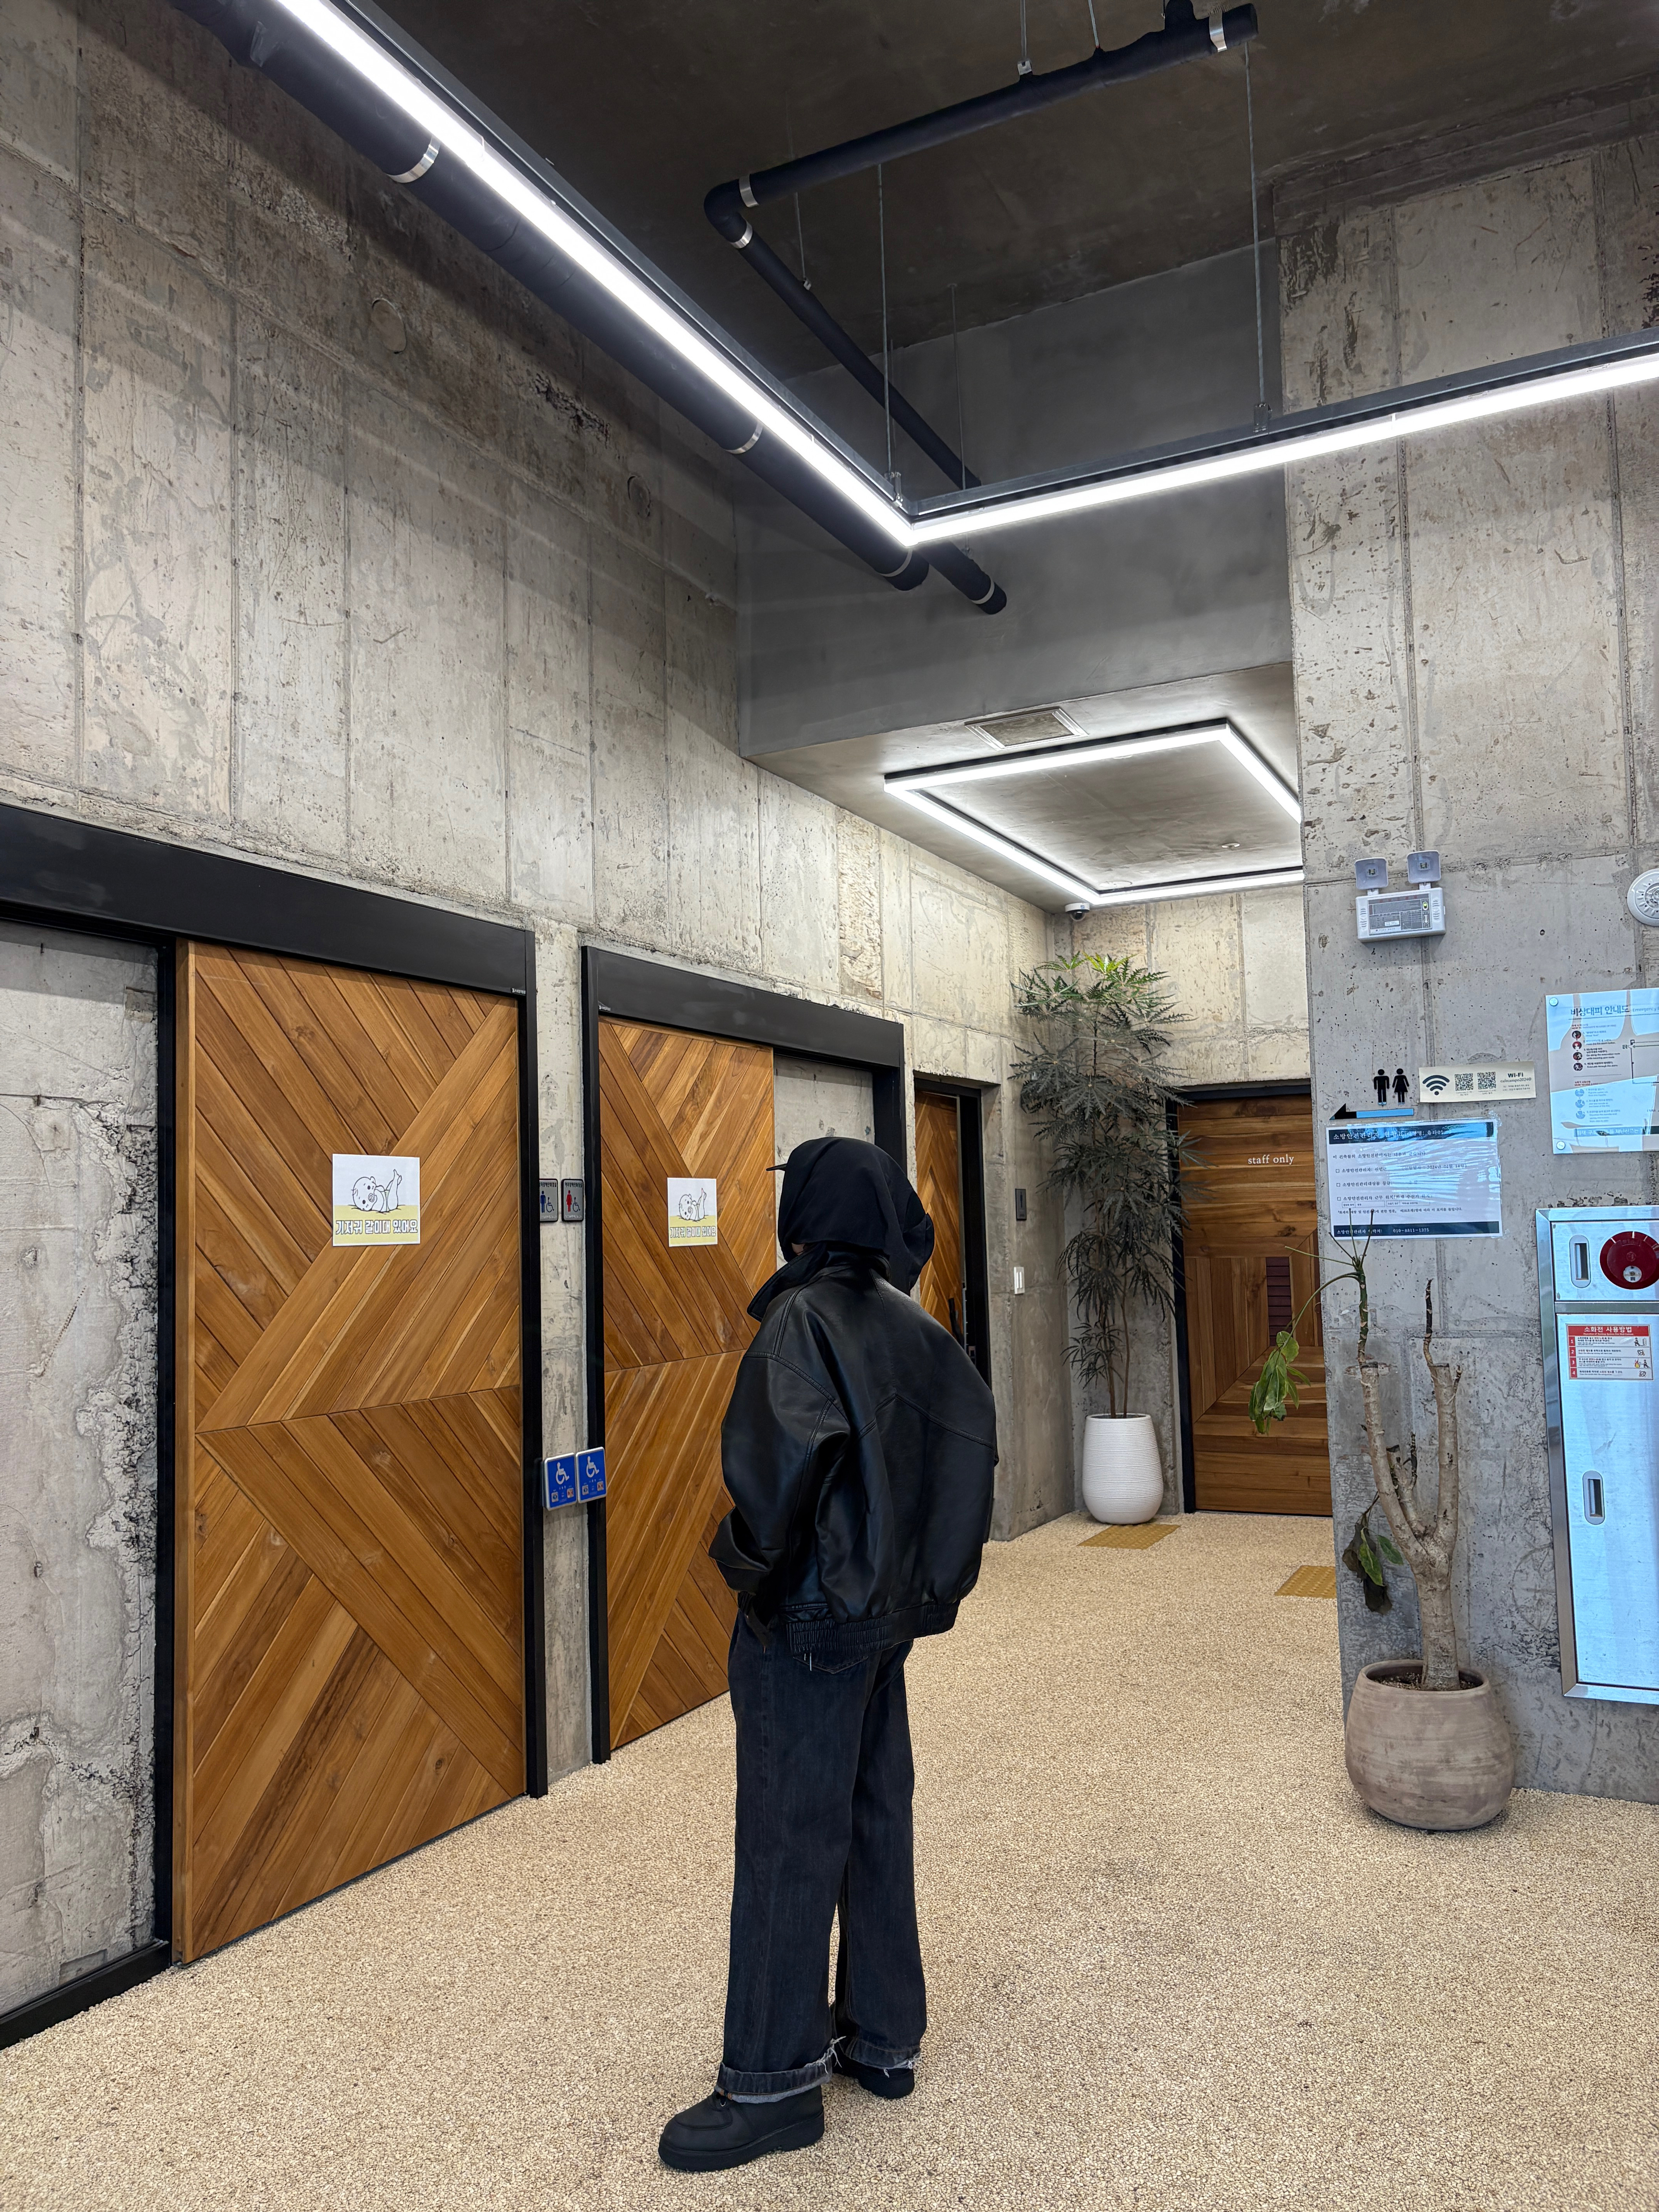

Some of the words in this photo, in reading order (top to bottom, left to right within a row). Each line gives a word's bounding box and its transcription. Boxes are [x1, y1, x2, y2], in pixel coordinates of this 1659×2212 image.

[1571, 1006, 1602, 1017] 비상대피
[1605, 1005, 1630, 1015] 안내도
[1248, 1154, 1269, 1164] staff
[1273, 1154, 1294, 1165] only
[336, 1220, 363, 1235] 기저귀
[365, 1219, 391, 1234] 갈이대
[393, 1219, 418, 1234] 있어요
[670, 1226, 686, 1238] 기저귀
[686, 1226, 701, 1238] 갈이대
[702, 1226, 716, 1237] 있어요
